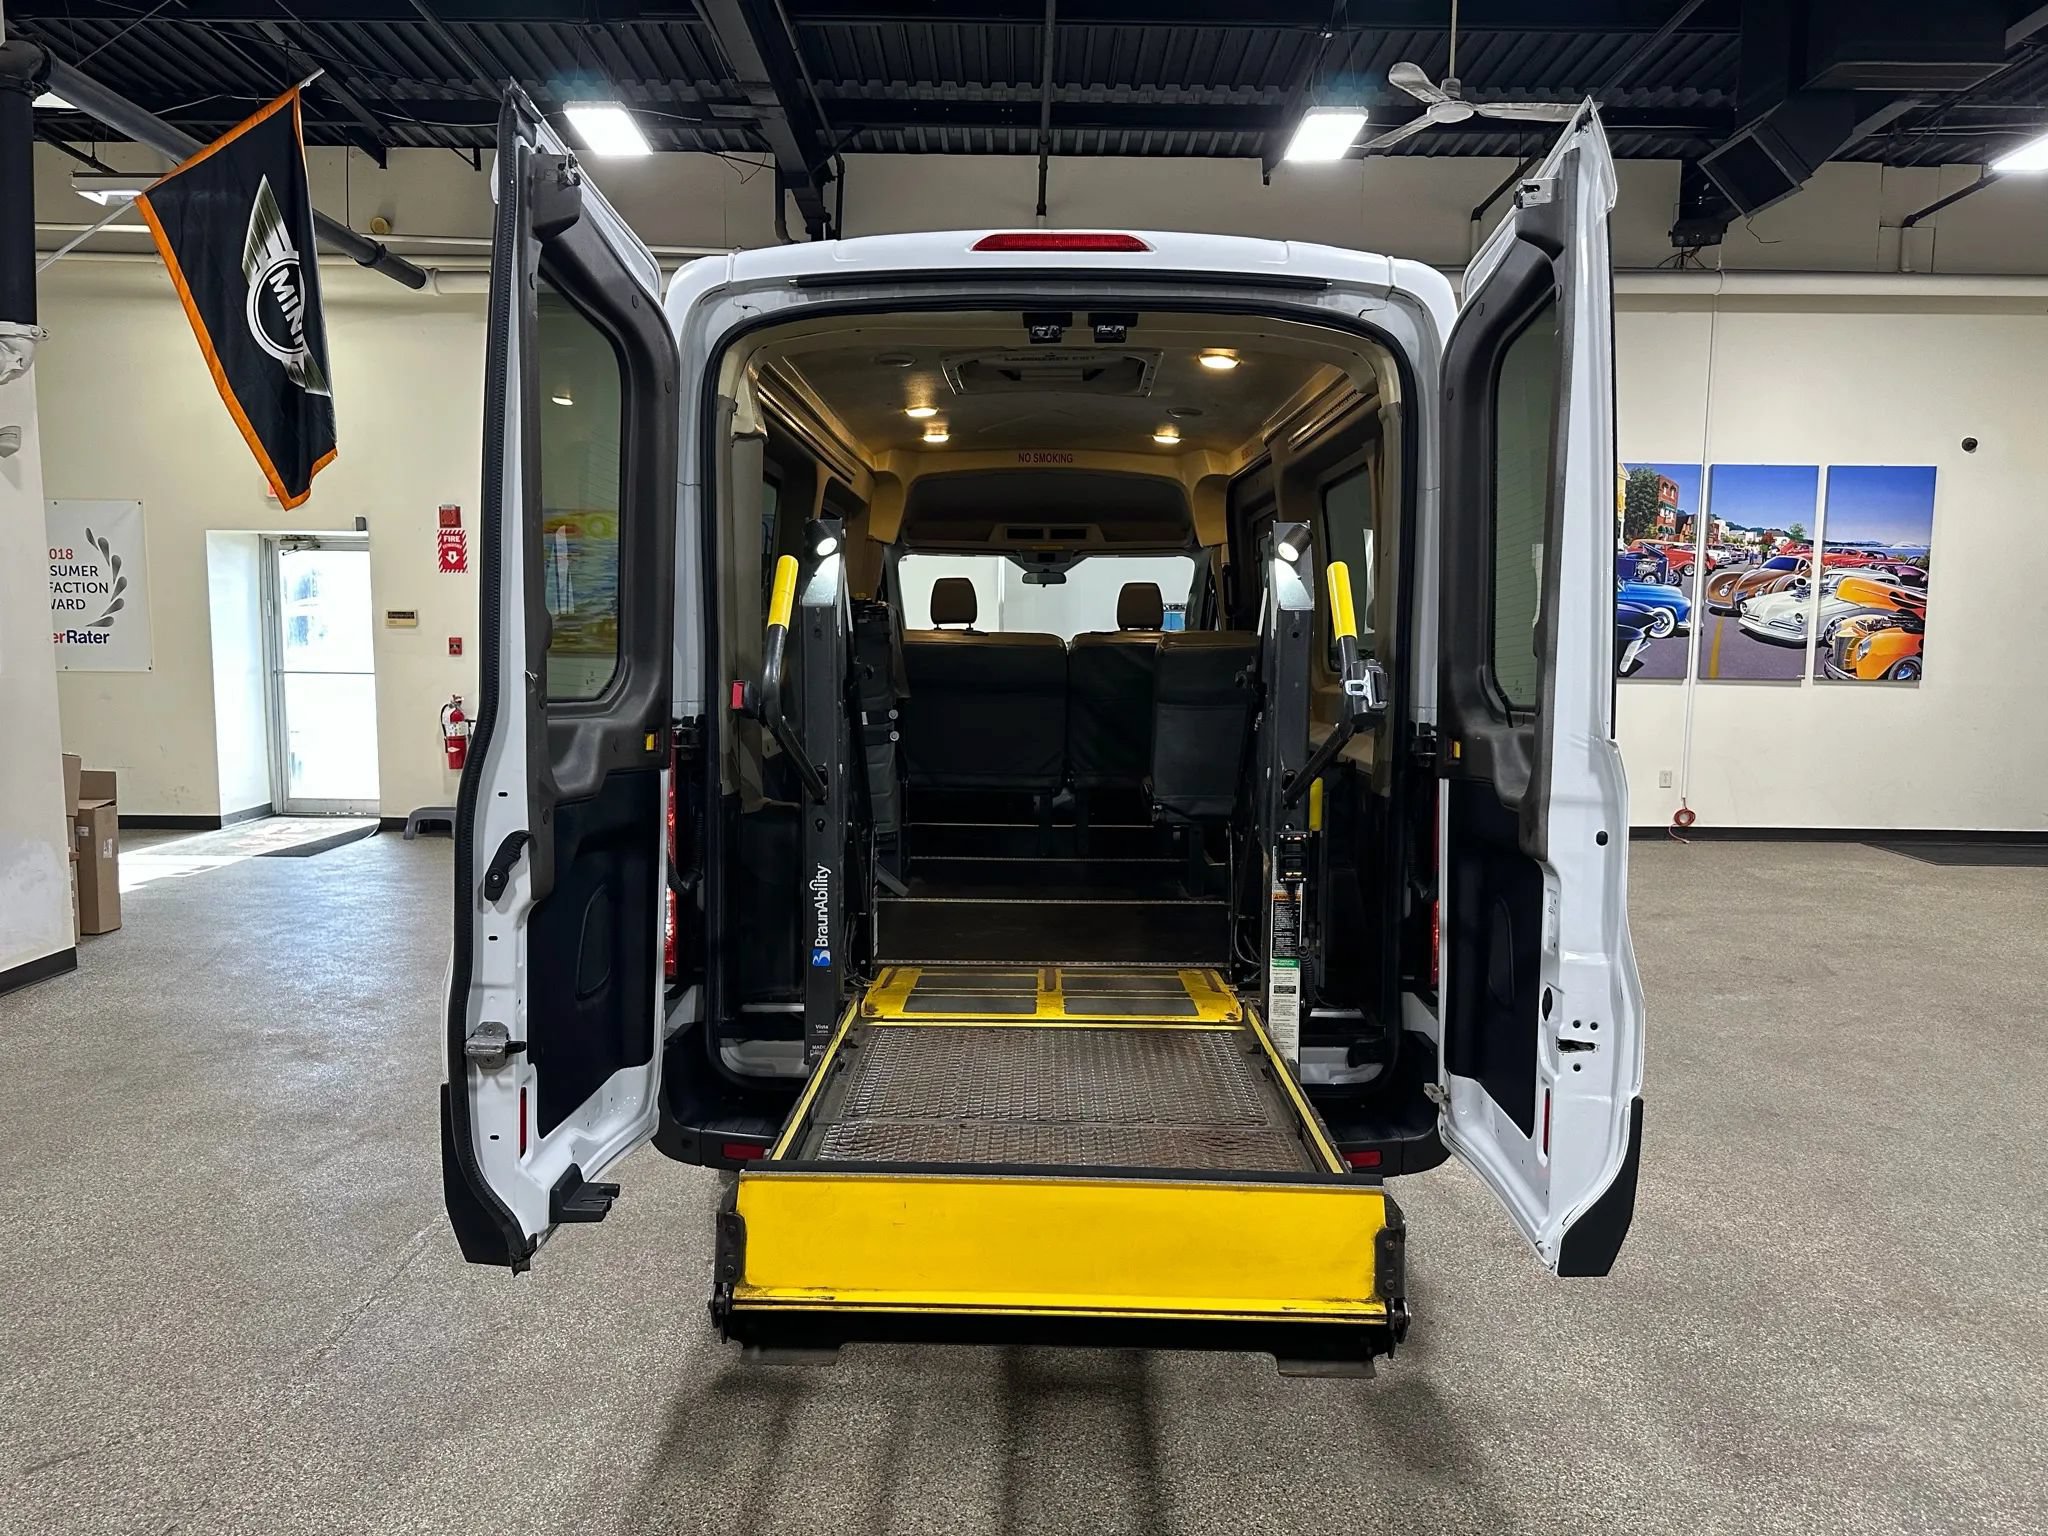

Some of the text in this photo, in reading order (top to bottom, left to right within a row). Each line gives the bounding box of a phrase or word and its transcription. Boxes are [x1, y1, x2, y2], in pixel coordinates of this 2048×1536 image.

[1018, 452, 1073, 464] NO SMOKING
[443, 535, 461, 543] FIRE
[50, 565, 99, 577] SUMER
[809, 863, 832, 947] BraunAbility
